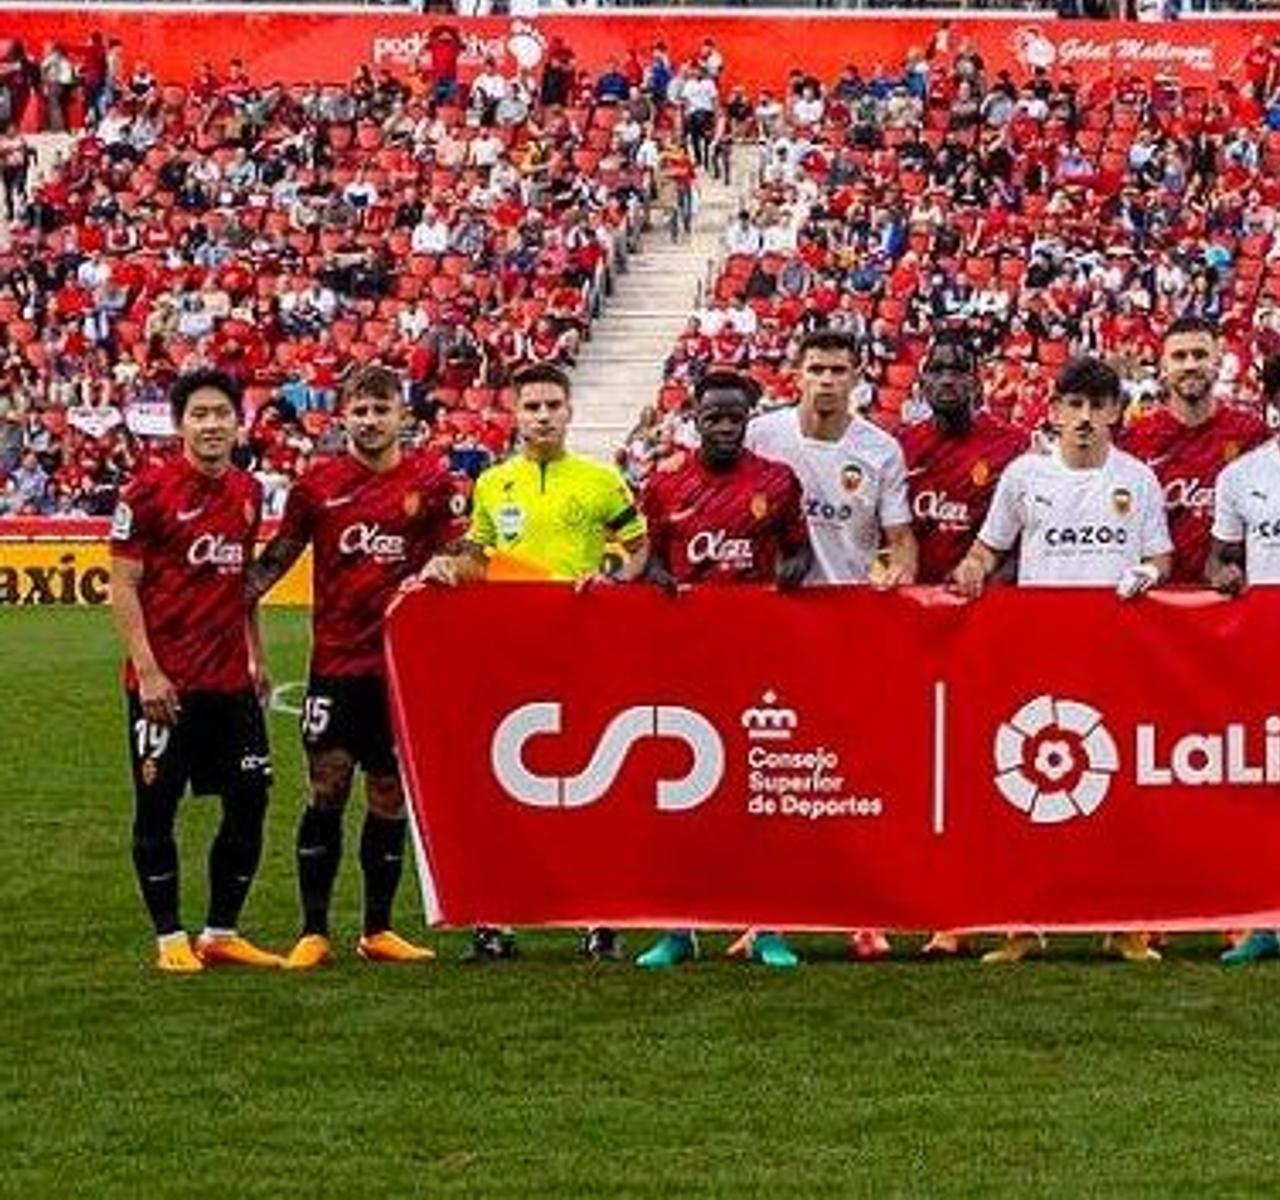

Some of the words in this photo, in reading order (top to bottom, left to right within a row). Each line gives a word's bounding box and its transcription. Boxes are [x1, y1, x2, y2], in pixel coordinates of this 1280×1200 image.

[806, 500, 852, 520] ZOO
[1044, 525, 1128, 546] CAZOO
[748, 747, 838, 773] Consejo
[748, 771, 845, 793] Superior
[748, 795, 777, 815] de
[780, 794, 884, 820] Deportes
